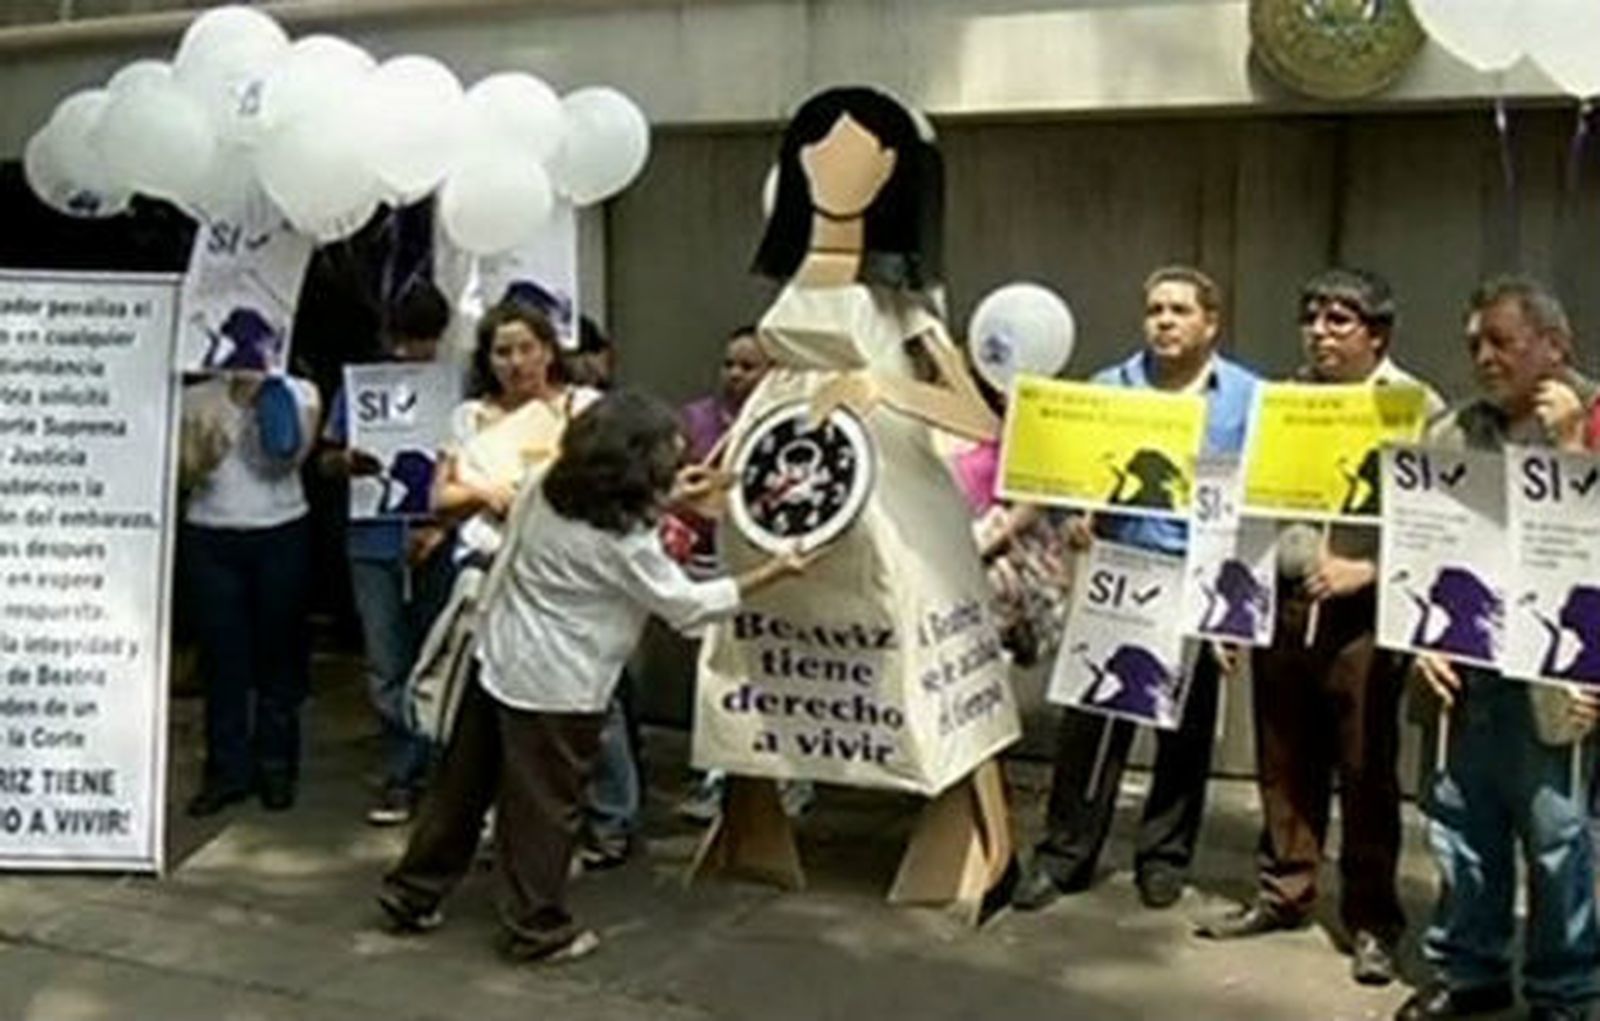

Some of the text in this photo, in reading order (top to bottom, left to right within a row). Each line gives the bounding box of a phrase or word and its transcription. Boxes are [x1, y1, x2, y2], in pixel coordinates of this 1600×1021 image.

[206, 226, 243, 256] SI
[358, 390, 388, 421] SI
[1395, 450, 1431, 491] SI
[1523, 457, 1561, 502] SI
[1088, 571, 1127, 607] SI
[761, 648, 874, 687] tiene
[722, 684, 904, 732] derecho
[753, 727, 895, 766] a vivir
[41, 767, 117, 797] TIENE
[29, 808, 48, 836] A
